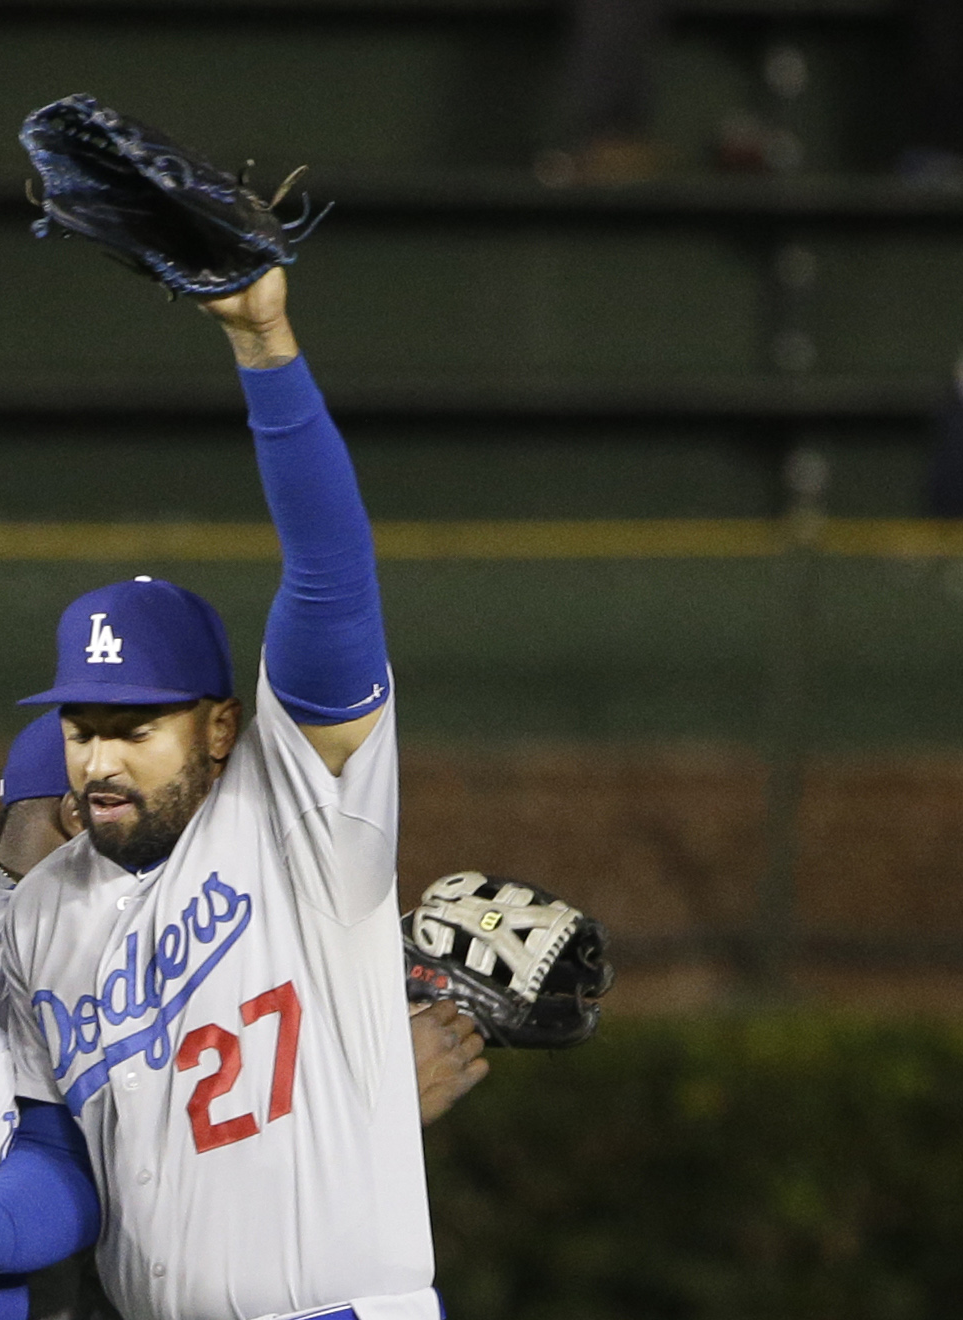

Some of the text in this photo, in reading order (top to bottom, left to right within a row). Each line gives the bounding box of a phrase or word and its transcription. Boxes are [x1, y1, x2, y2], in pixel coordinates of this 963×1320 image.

[85, 613, 123, 664] LA
[30, 871, 252, 1084] Dodgers
[174, 980, 302, 1154] 27
